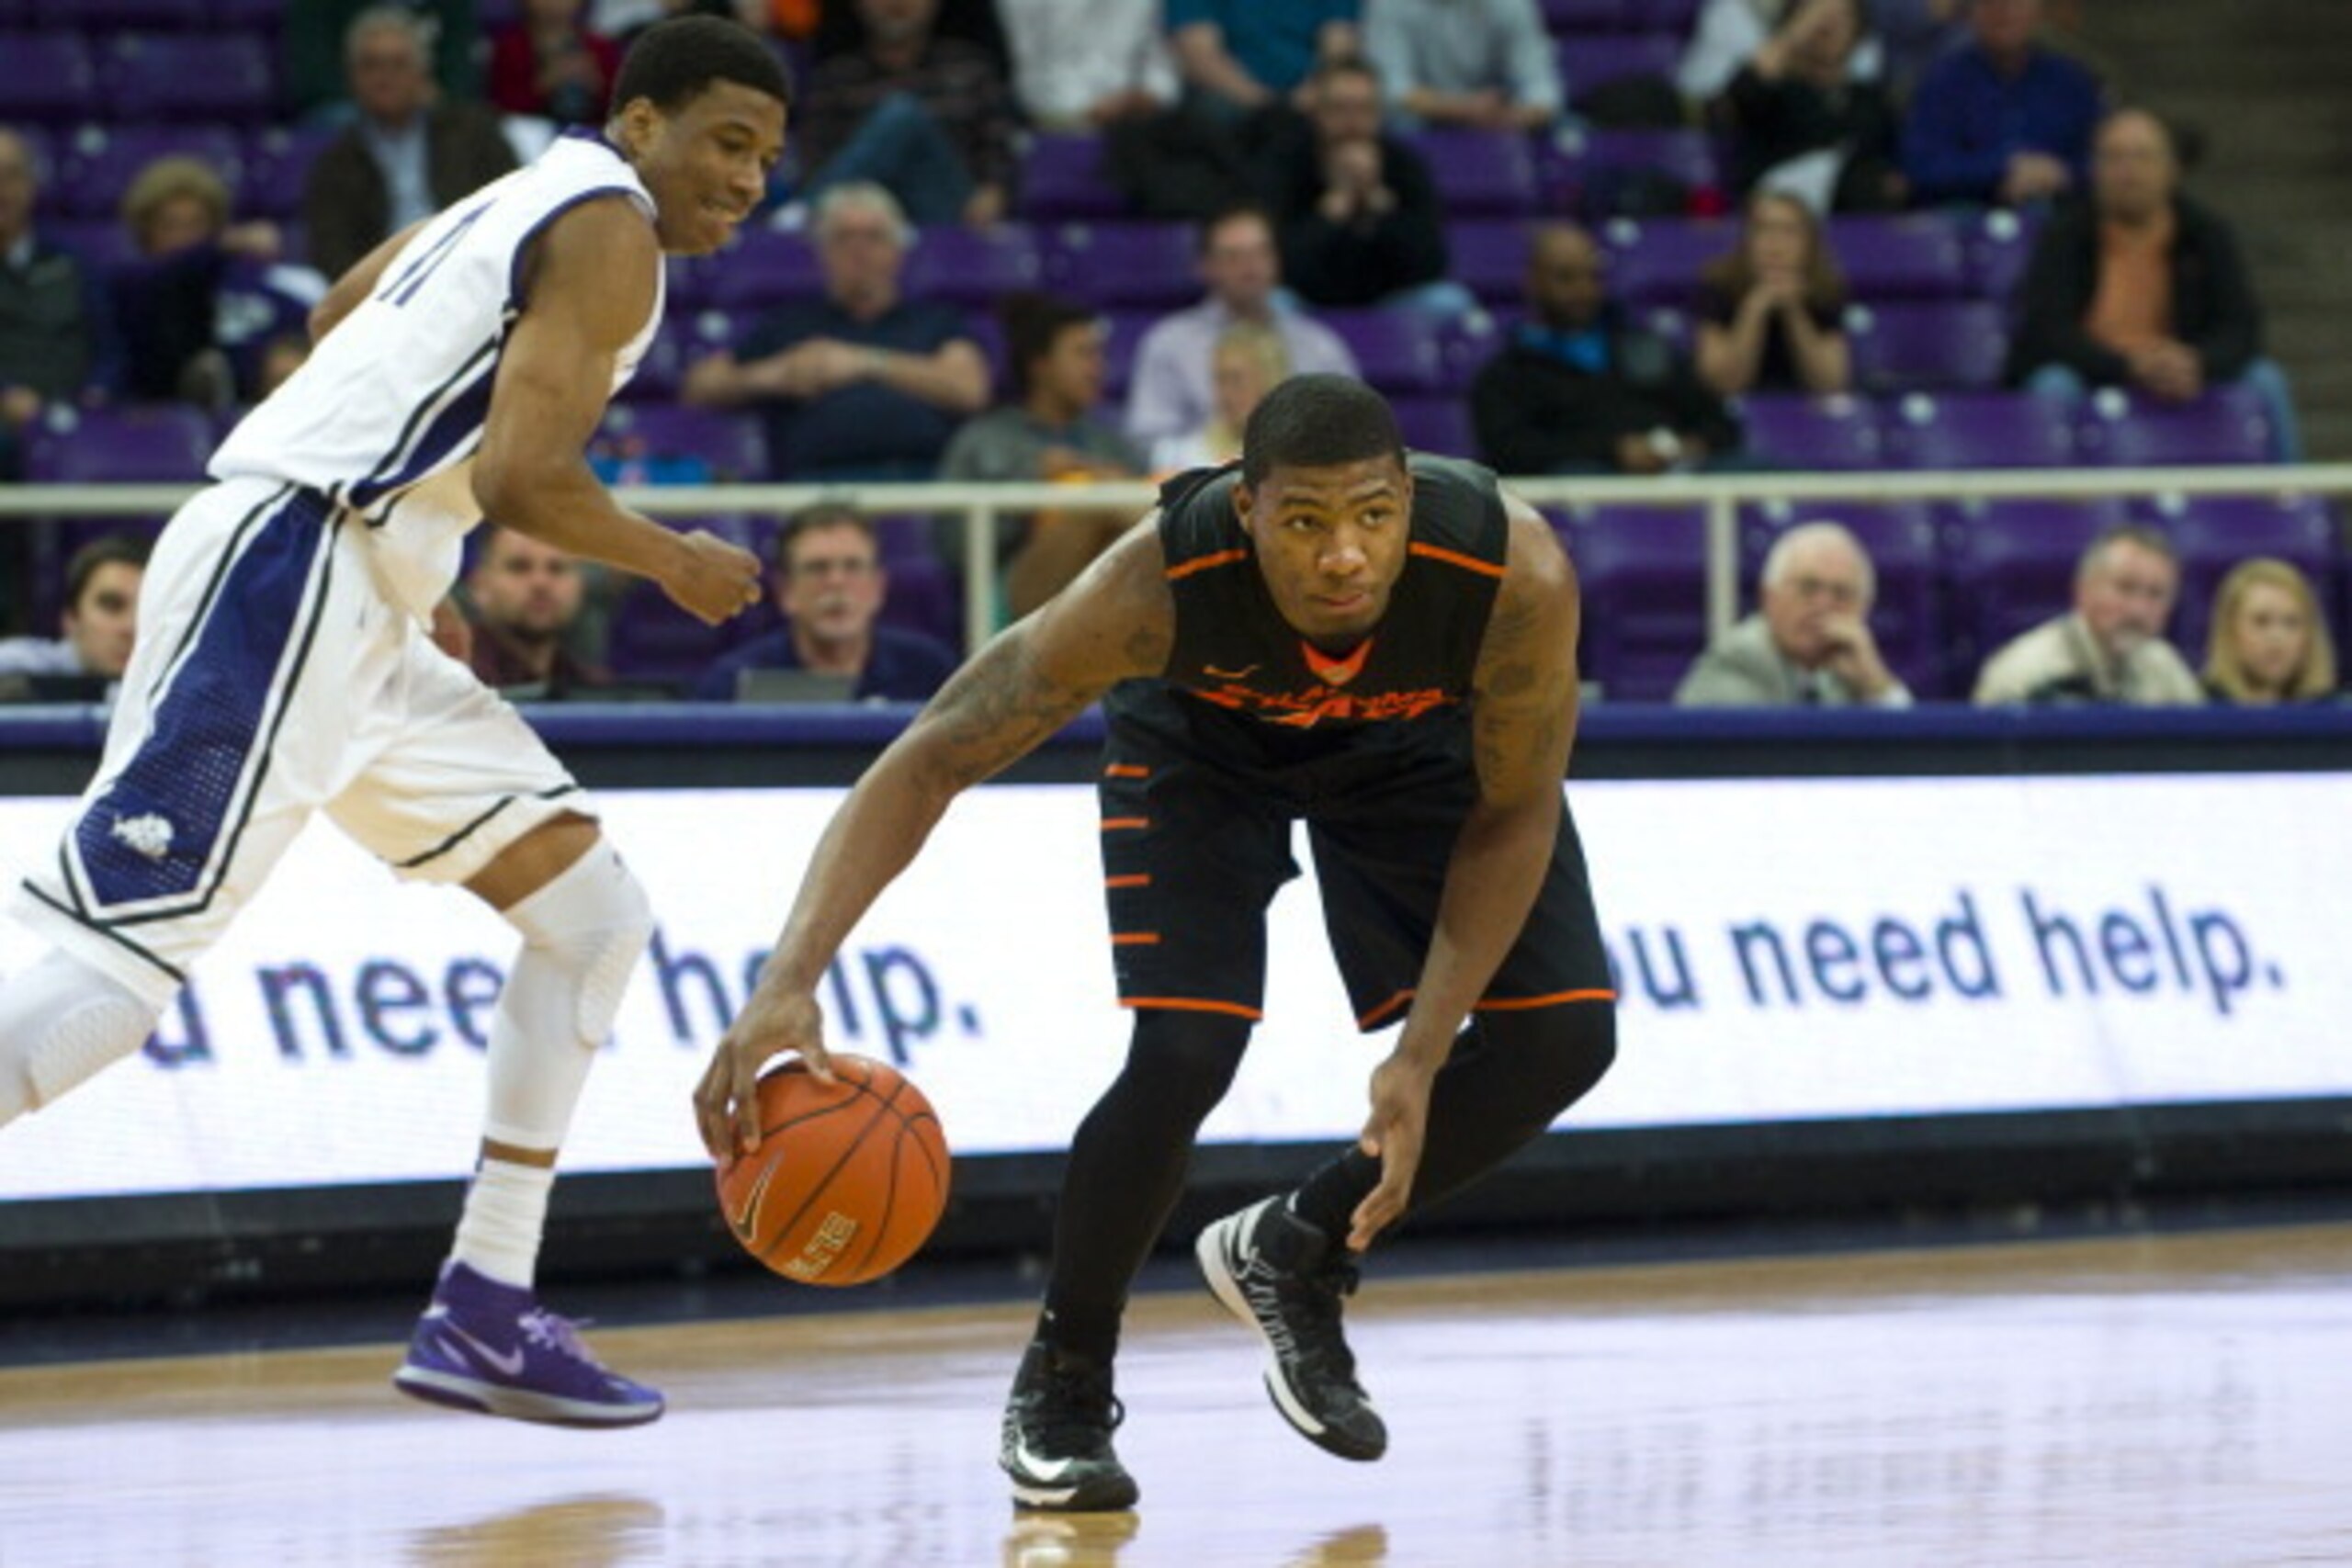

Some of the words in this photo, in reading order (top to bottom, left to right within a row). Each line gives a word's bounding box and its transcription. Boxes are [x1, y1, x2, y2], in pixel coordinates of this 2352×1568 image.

[257, 957, 614, 1058] nee
[1729, 891, 2003, 1006] need
[2022, 884, 2285, 1016] help.
